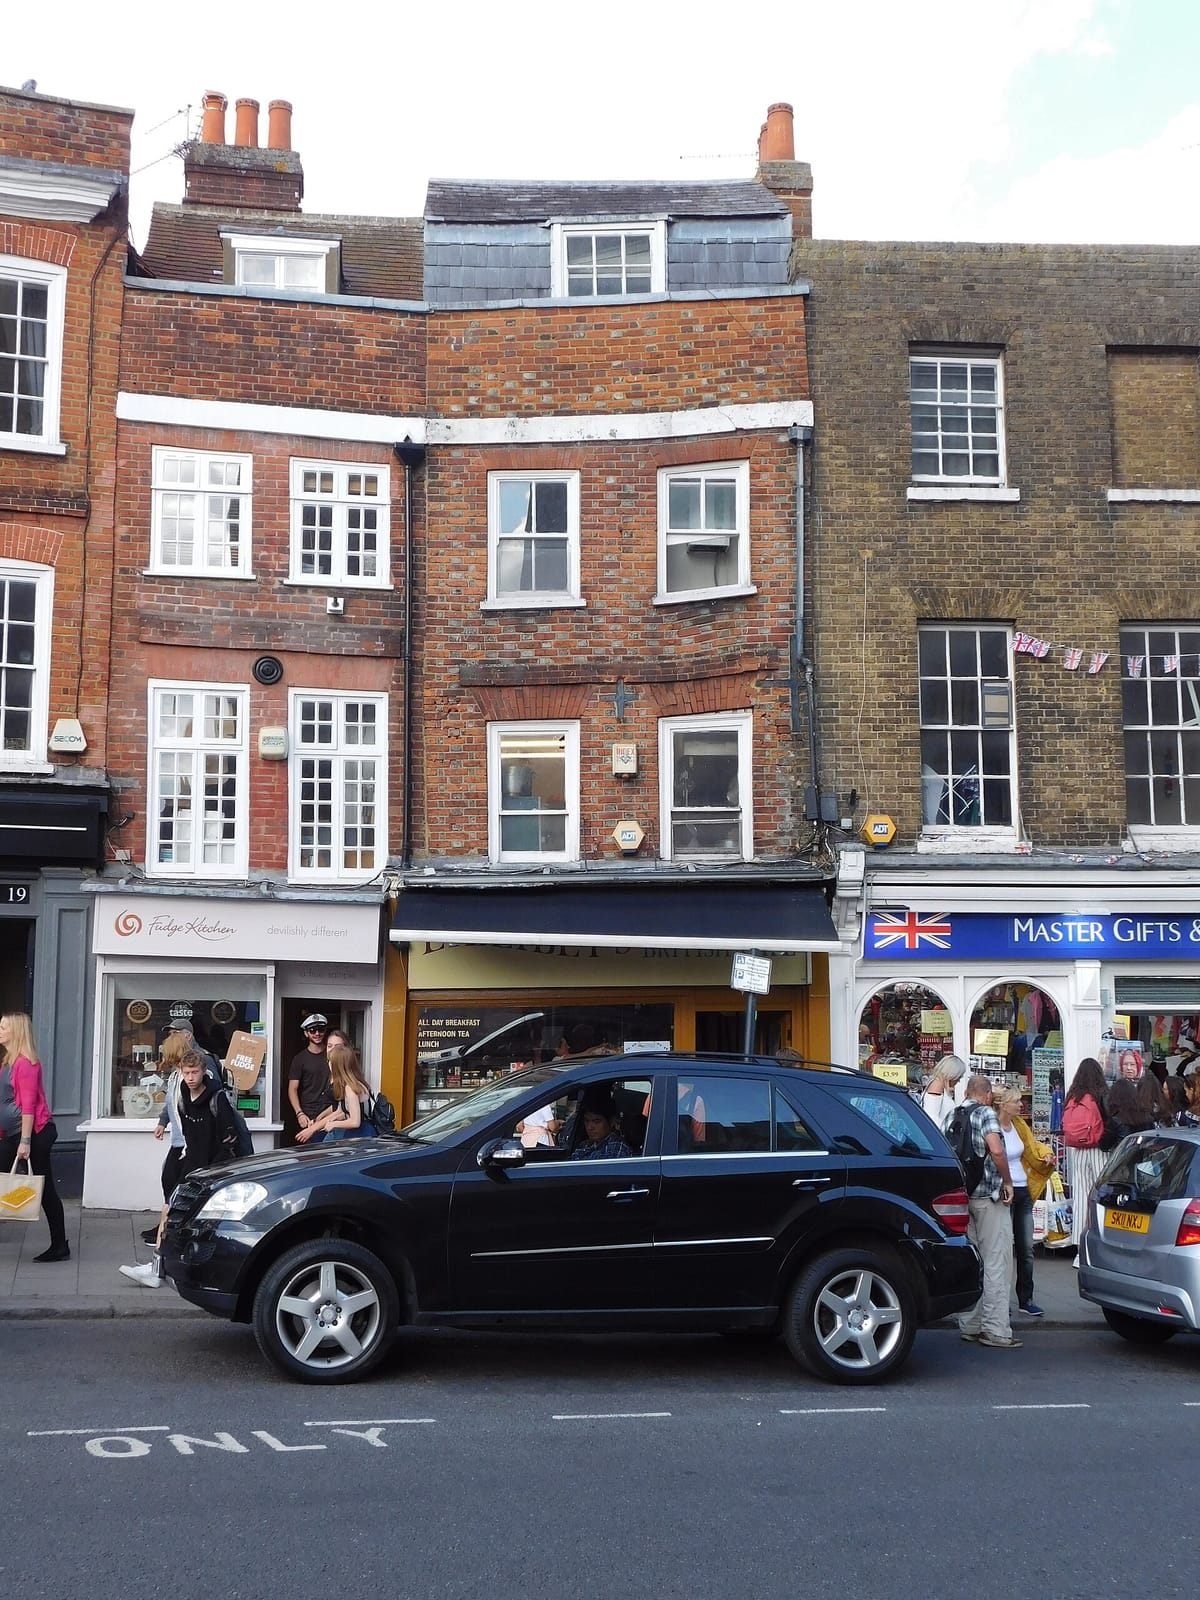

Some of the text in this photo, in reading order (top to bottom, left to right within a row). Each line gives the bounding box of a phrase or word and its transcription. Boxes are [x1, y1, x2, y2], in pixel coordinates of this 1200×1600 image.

[54, 735, 82, 743] SECOM
[873, 823, 888, 834] ADT
[621, 831, 637, 841] ADT
[8, 887, 27, 902] 19
[149, 914, 238, 941] Fudge Kitchen
[267, 925, 349, 938] devilishly different
[1013, 917, 1106, 943] MASTER
[1112, 917, 1182, 943] GIFTS
[169, 1009, 194, 1017] taste
[417, 1018, 430, 1026] ALL
[431, 1018, 444, 1026] DAY
[417, 1030, 470, 1038] AFTERNOON TEA
[418, 1040, 440, 1048] LUNCH
[236, 1054, 253, 1063] FREE
[230, 1059, 255, 1070] FUDGE
[84, 1426, 390, 1458] ONLY
